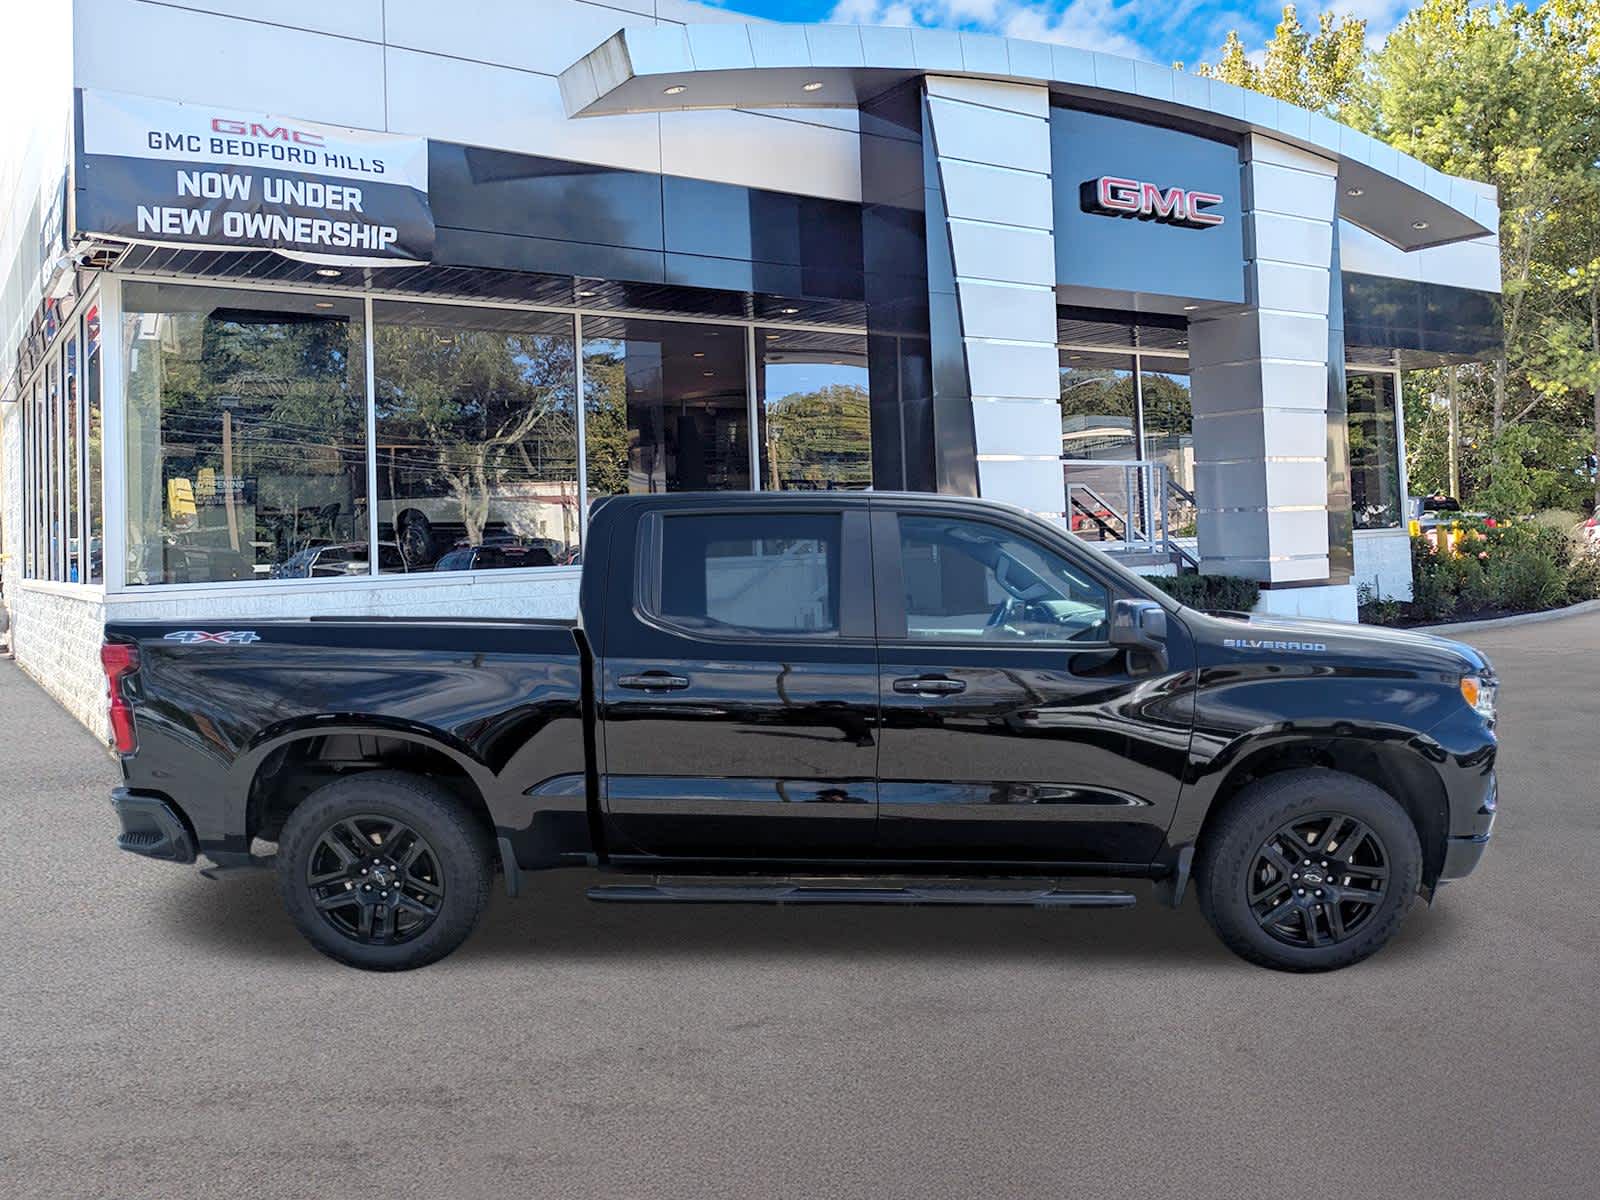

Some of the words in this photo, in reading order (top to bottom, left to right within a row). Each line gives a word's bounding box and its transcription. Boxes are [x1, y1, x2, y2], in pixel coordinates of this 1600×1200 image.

[148, 131, 201, 152] GMC
[210, 138, 316, 165] BEDFORD
[324, 153, 385, 174] HILLS
[211, 118, 326, 148] GMC
[176, 170, 252, 201] NOW
[263, 177, 363, 213] UNDER
[1096, 175, 1225, 225] GMC
[136, 206, 211, 236] NEW
[223, 211, 398, 250] OWNERSHIP
[1223, 639, 1327, 652] SILVERADO
